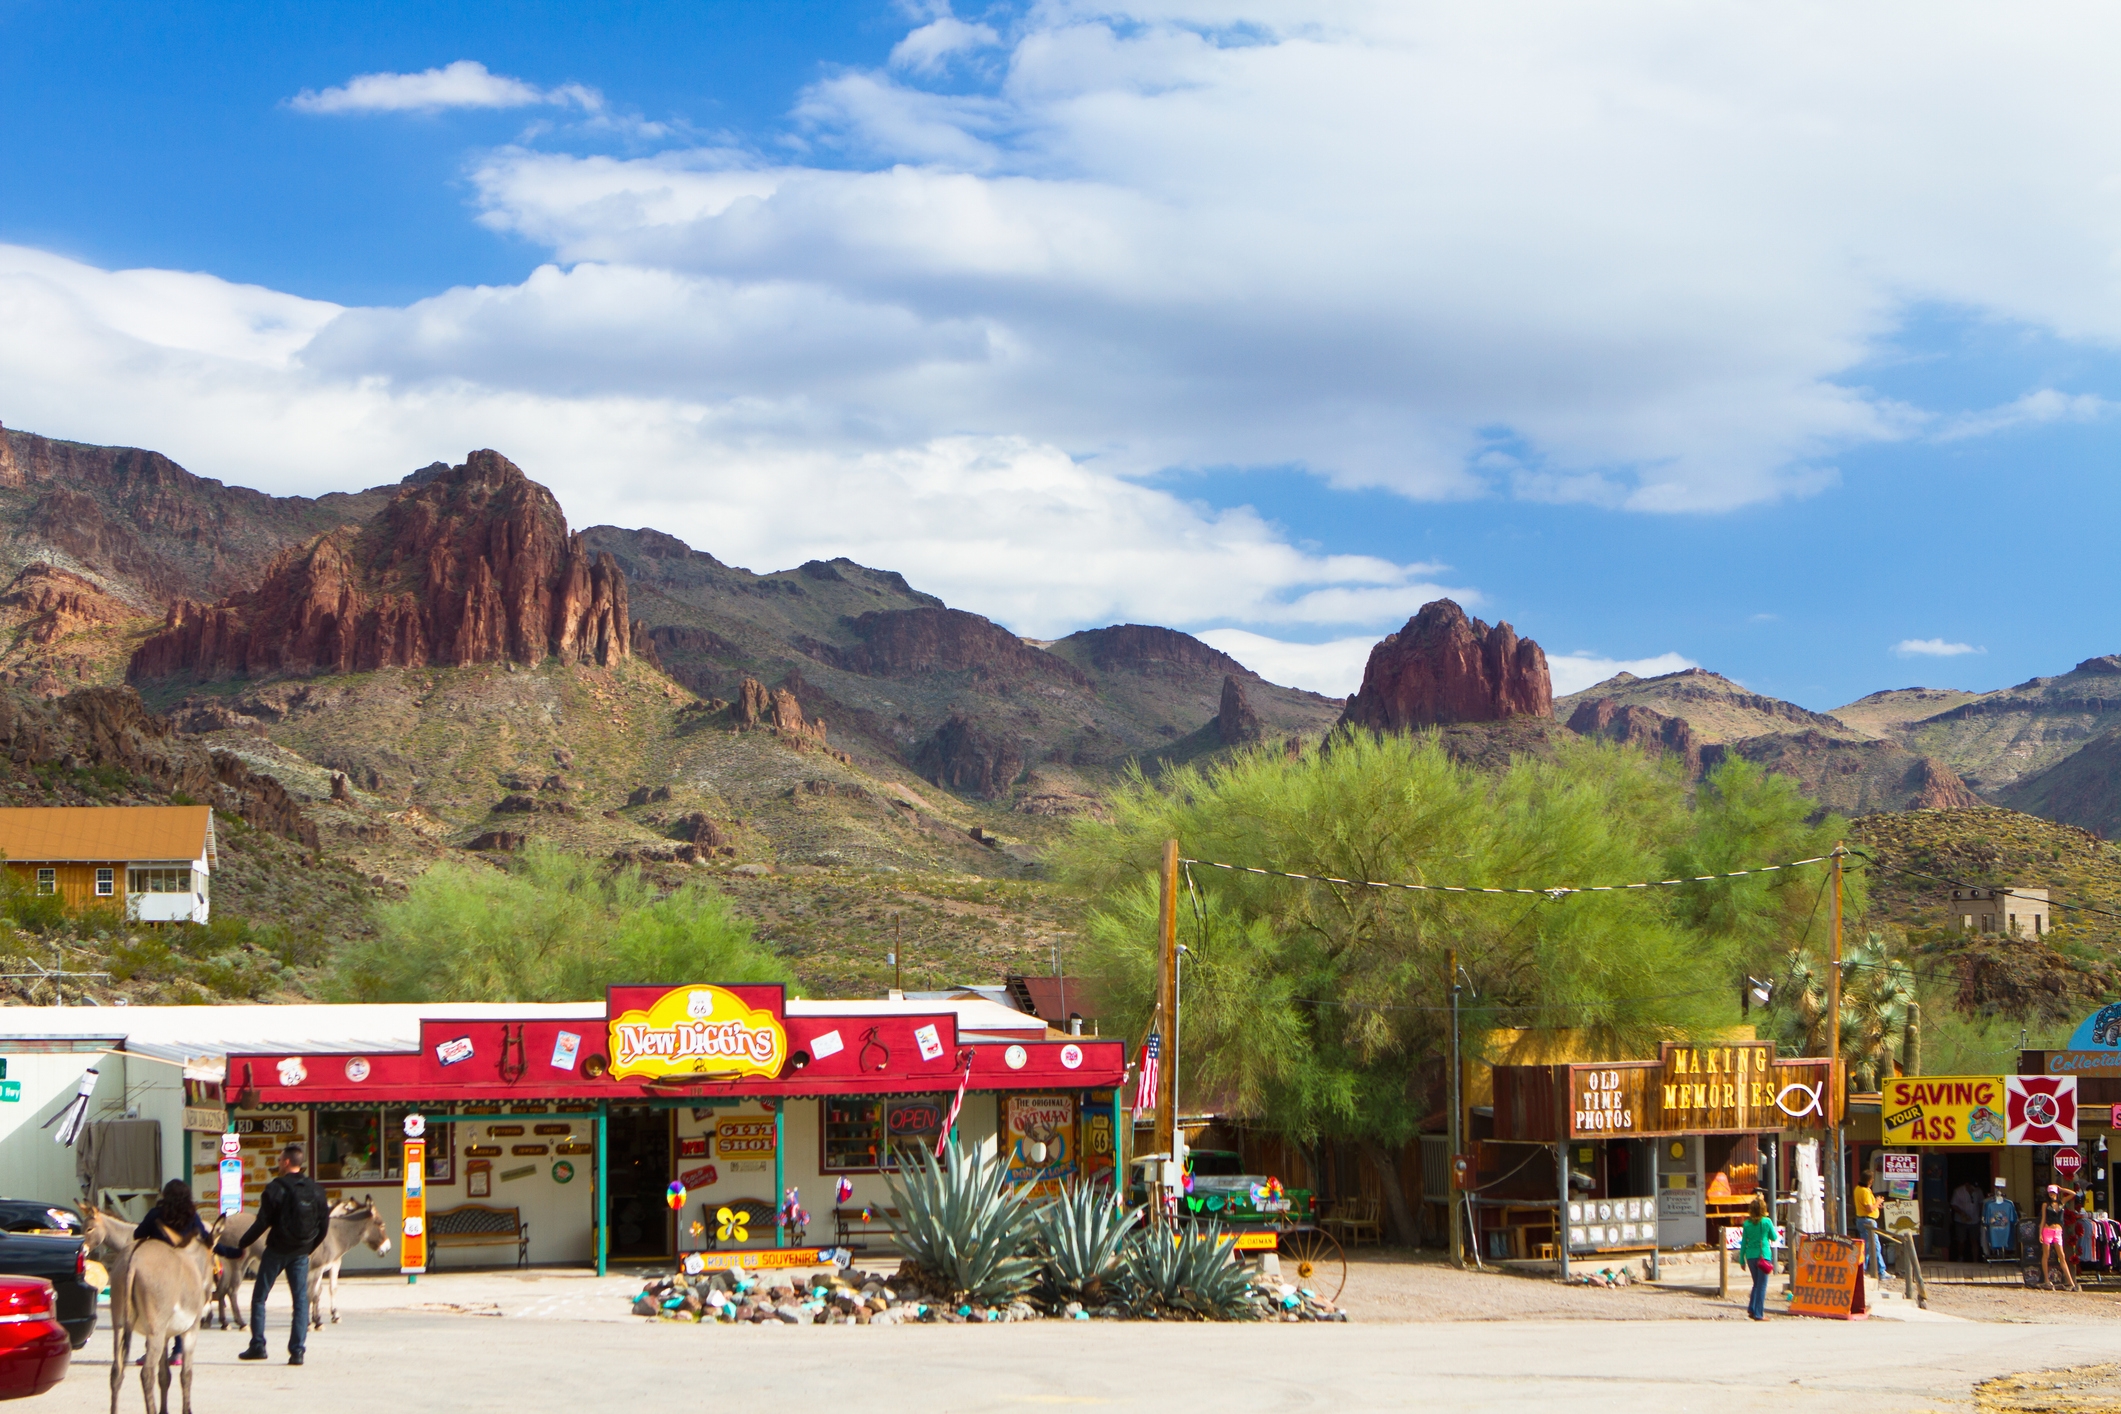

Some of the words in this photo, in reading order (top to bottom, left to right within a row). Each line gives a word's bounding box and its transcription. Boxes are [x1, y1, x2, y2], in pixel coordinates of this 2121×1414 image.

[693, 1005, 706, 1014] 66
[620, 1026, 677, 1063] New
[1674, 1047, 1767, 1074] MAKING
[1589, 1071, 1619, 1090] OLD
[1015, 1097, 1030, 1110] THE
[1031, 1098, 1063, 1107] ORIGINAL
[1583, 1091, 1623, 1110] TIME
[1663, 1081, 1776, 1110] MEMORIES
[1894, 1082, 1995, 1106] SAVING
[262, 1118, 294, 1133] SIGNS
[889, 1108, 937, 1129] OPEN
[1575, 1109, 1632, 1129] PHOTOS
[1888, 1106, 1921, 1127] YOUR
[720, 1122, 775, 1137] GIFT
[1911, 1116, 1956, 1141] ASS
[1094, 1132, 1106, 1151] 66
[1886, 1161, 1916, 1169] SALE
[2055, 1156, 2080, 1167] WHOA
[1247, 1237, 1273, 1246] OATMAN
[707, 1255, 740, 1267] ROUTE
[743, 1254, 758, 1267] 66
[761, 1251, 819, 1267] SOUVENIRS
[836, 1256, 846, 1266] 66
[1813, 1242, 1847, 1262] OLD
[1807, 1264, 1848, 1285] TIME
[1793, 1285, 1851, 1308] PHOTOS
